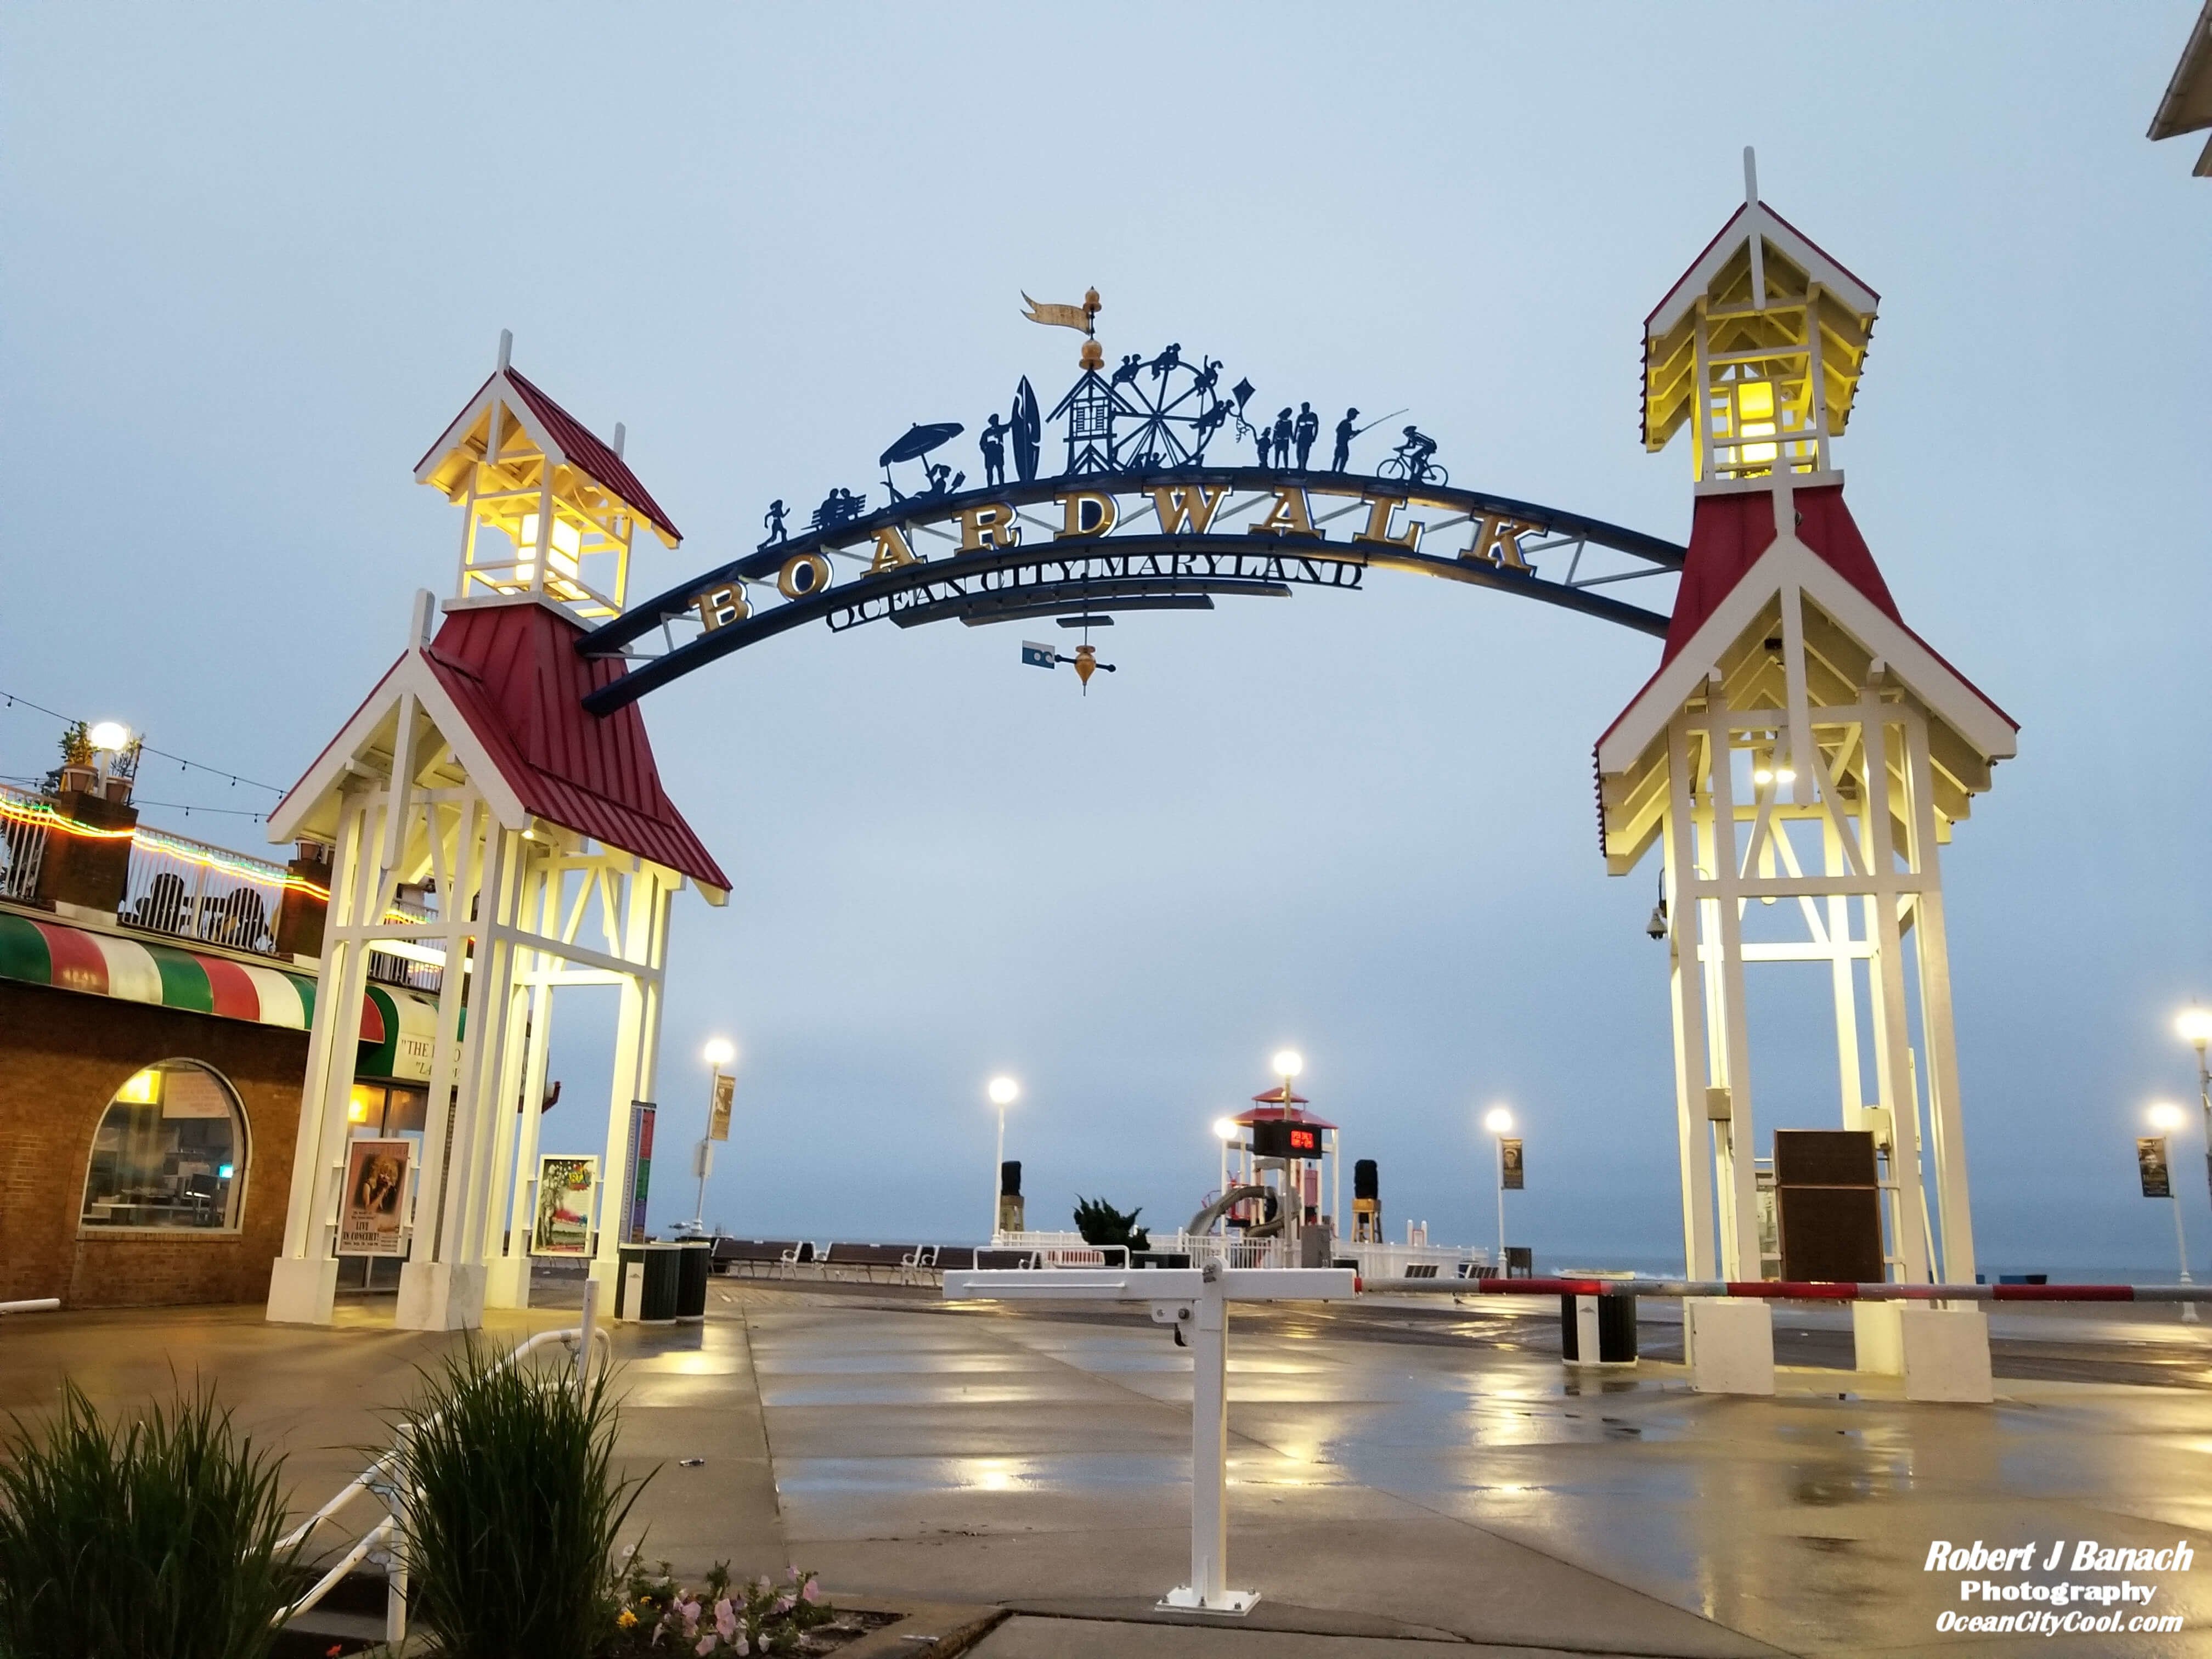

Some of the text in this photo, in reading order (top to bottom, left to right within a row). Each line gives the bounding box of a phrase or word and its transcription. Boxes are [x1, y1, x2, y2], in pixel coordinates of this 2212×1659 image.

[688, 483, 1549, 637] BOARDWALK
[826, 553, 1363, 632] OCEAN CITY MARYLAND
